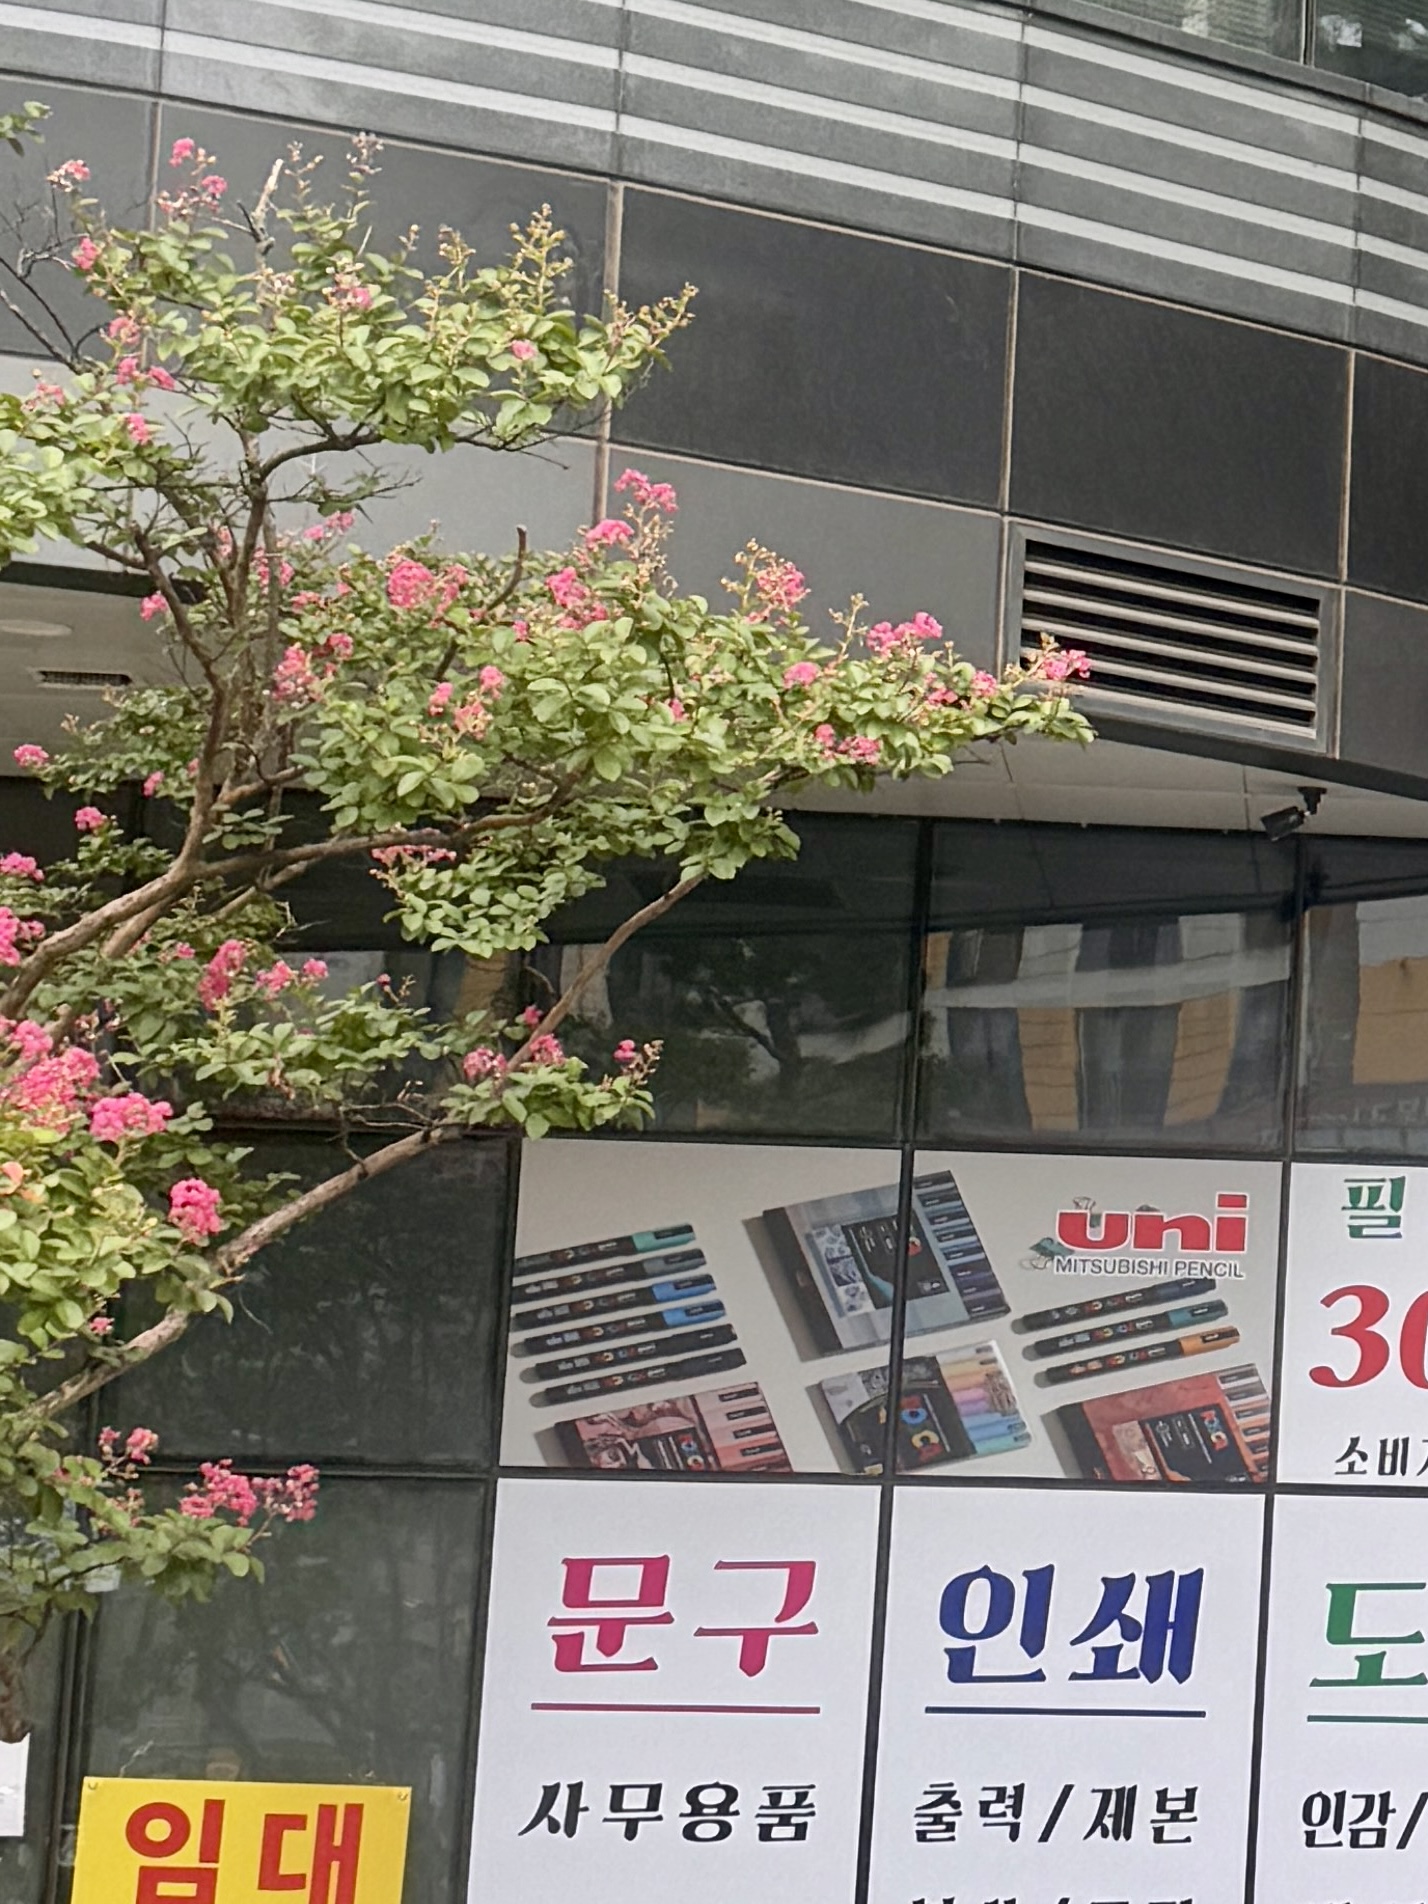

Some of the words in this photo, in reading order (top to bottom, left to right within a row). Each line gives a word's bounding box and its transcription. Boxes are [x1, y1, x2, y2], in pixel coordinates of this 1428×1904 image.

[1056, 1192, 1248, 1253] uni
[1055, 1257, 1167, 1275] MITSUBISHI
[1175, 1260, 1244, 1277] PENCIL
[546, 1556, 820, 1678] 문구
[939, 1564, 1204, 1685] 인쇄
[518, 1779, 818, 1845] 사무용품
[913, 1784, 1201, 1847] 출력/제본
